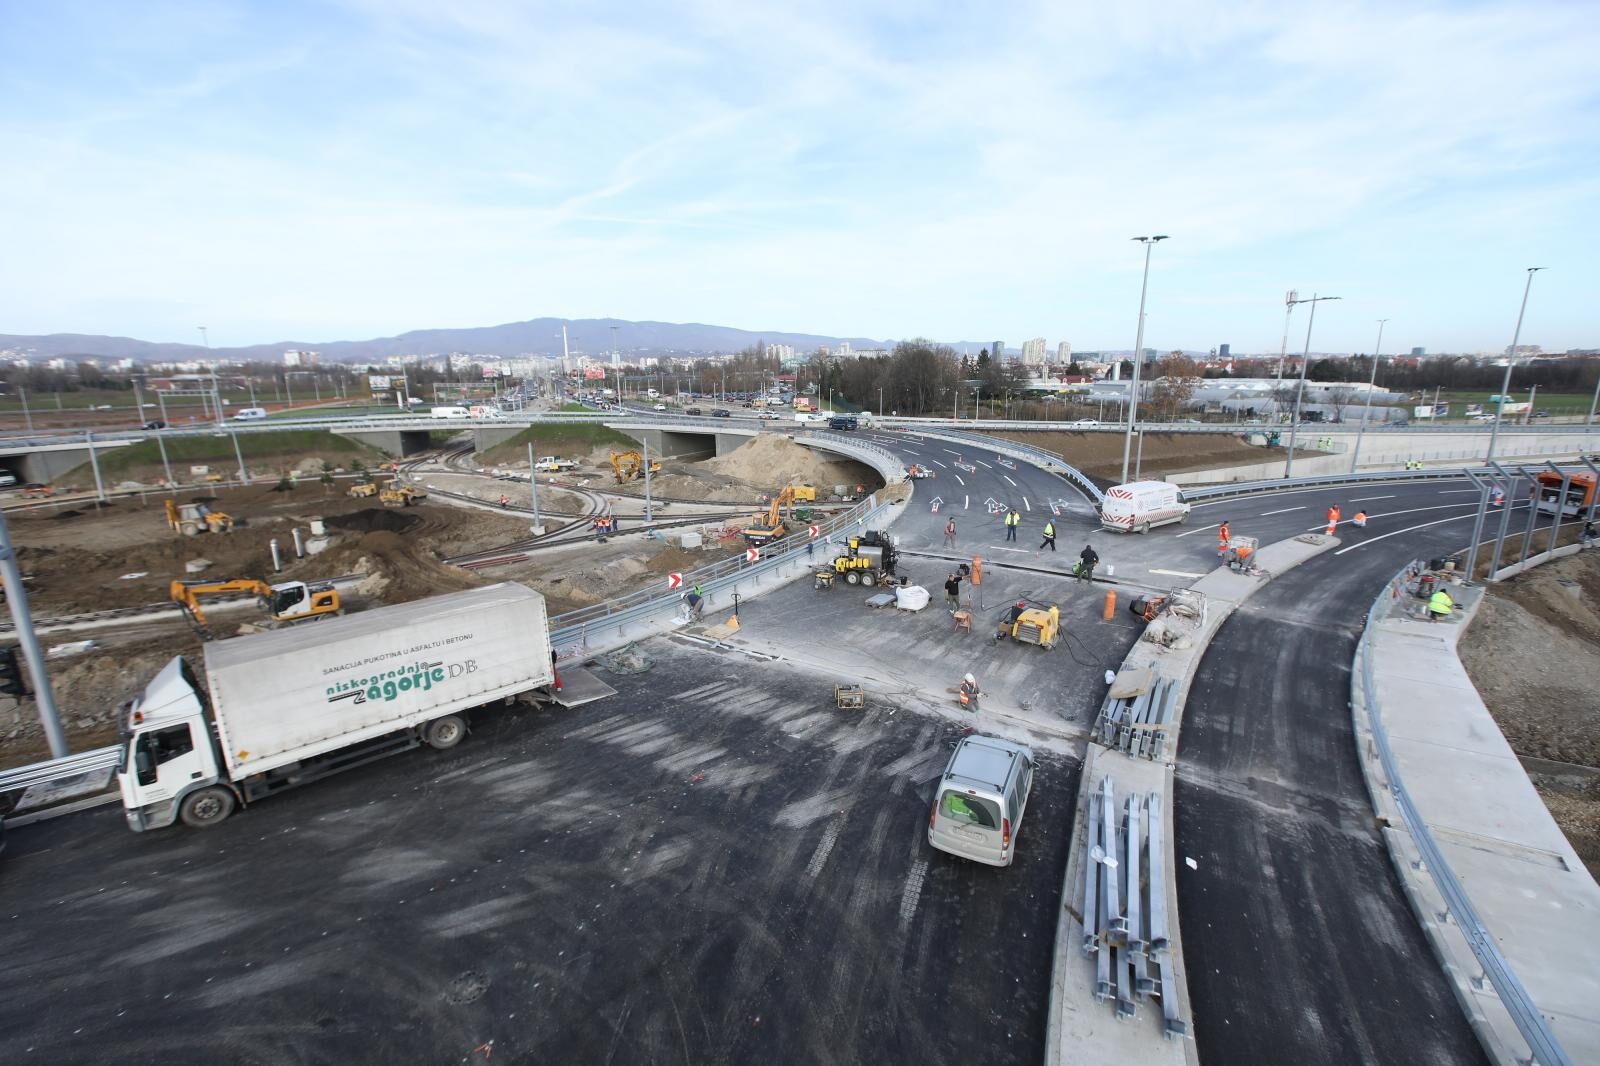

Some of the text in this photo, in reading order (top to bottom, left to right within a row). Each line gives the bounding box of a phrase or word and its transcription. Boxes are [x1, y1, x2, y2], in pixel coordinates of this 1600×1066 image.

[323, 660, 366, 675] SANACIJA
[364, 650, 402, 664] PUKOTINA
[411, 641, 441, 653] ASFALTU
[446, 633, 473, 644] BETONU
[448, 660, 478, 679] DB
[326, 661, 443, 695] niskogradnja
